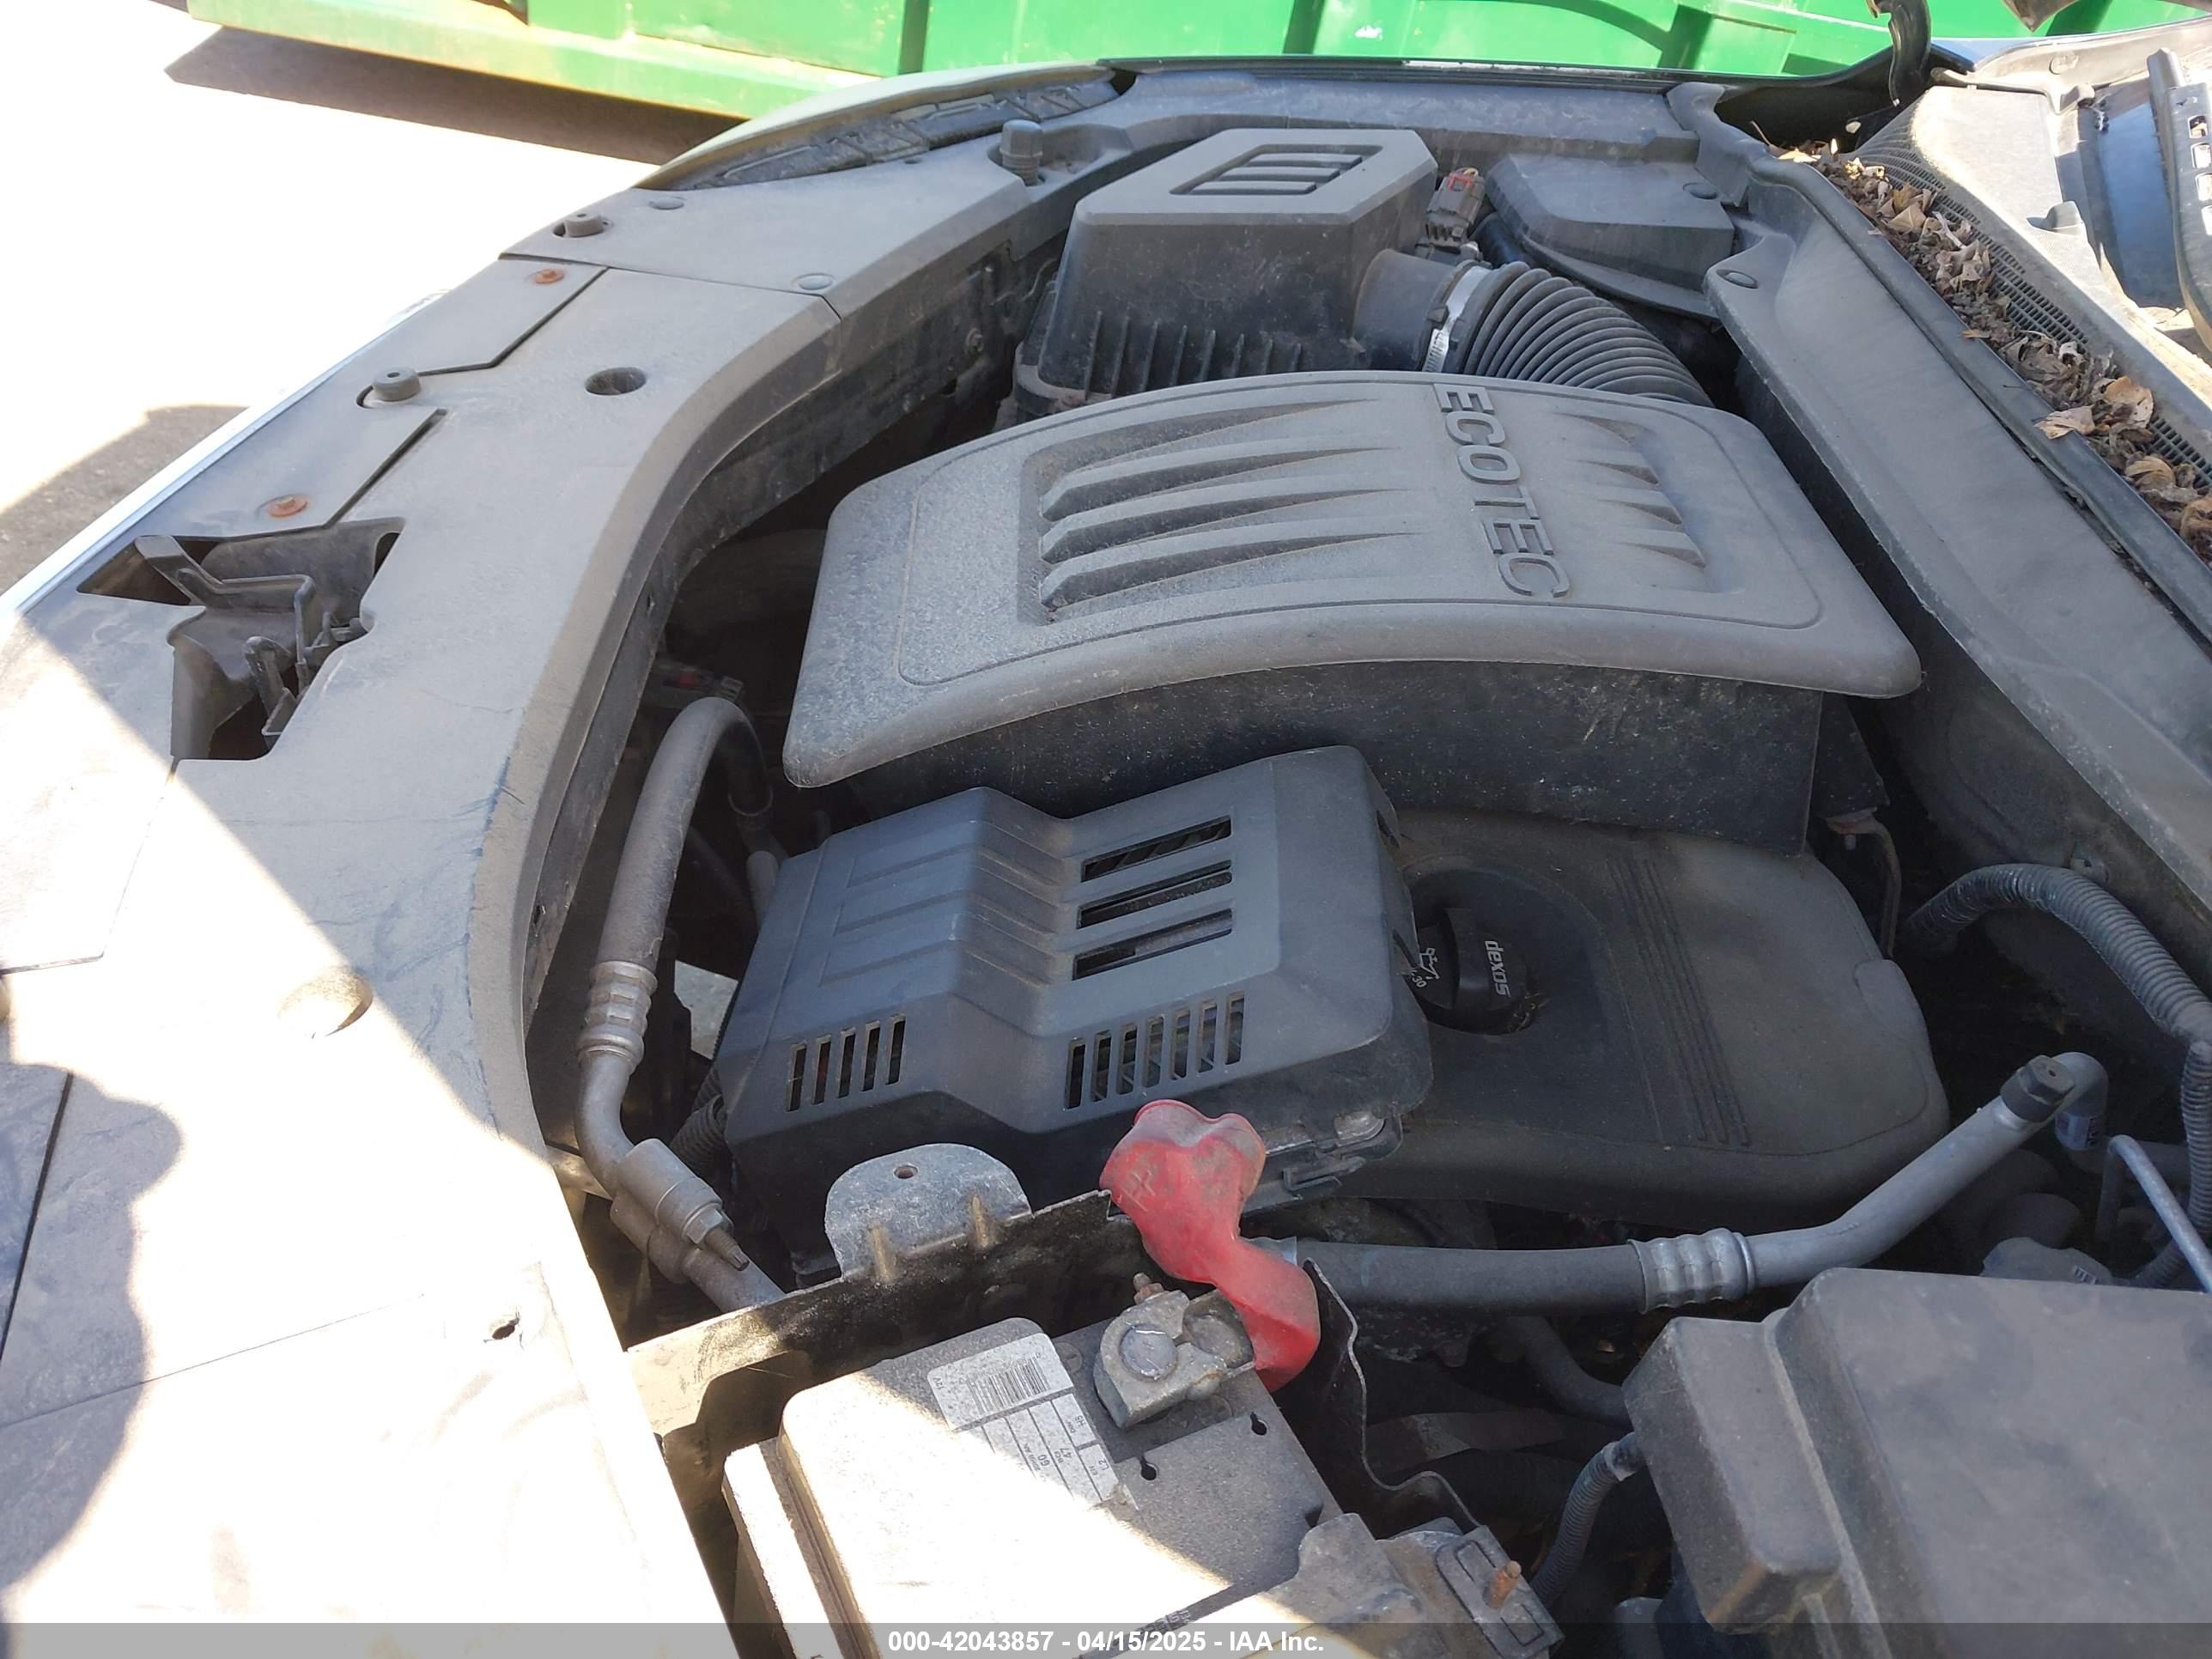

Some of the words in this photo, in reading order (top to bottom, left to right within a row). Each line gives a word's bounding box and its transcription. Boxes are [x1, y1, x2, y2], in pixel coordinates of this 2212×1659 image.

[1433, 383, 1571, 598] ECOTEC
[1485, 940, 1511, 998] dexos
[1037, 1454, 1050, 1467] 60
[1059, 1448, 1073, 1459] 47
[1098, 1457, 1109, 1471] L2
